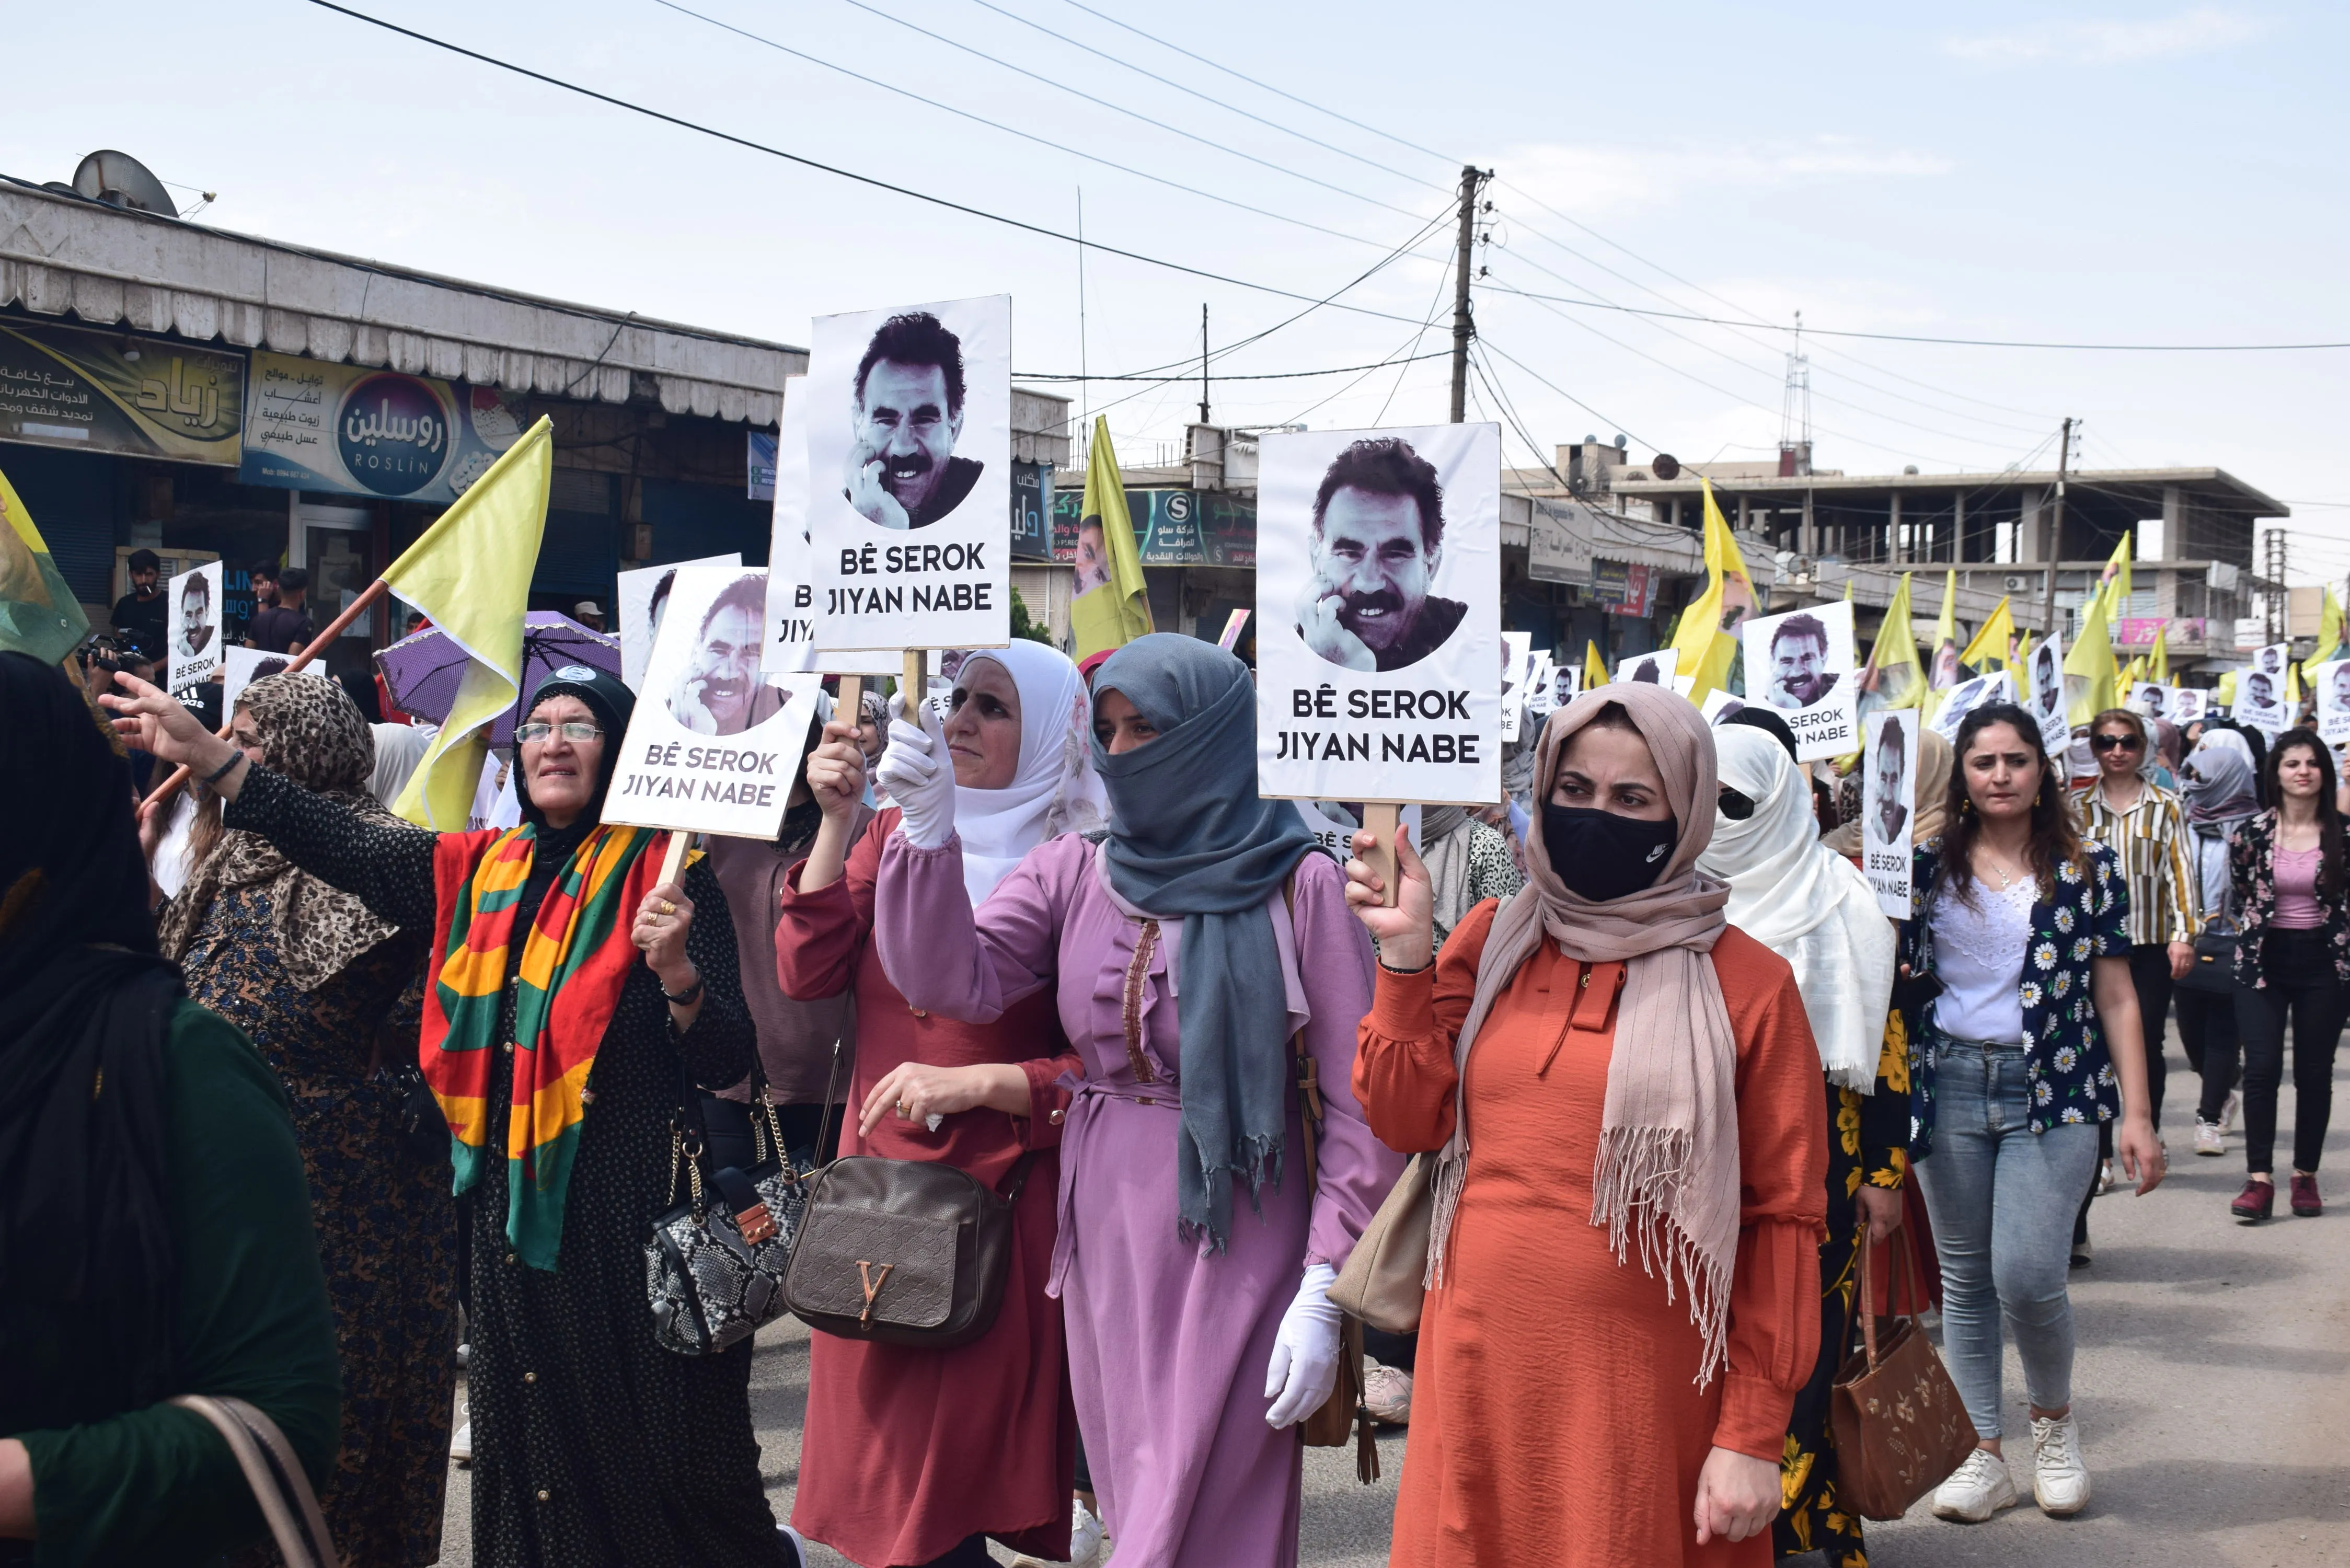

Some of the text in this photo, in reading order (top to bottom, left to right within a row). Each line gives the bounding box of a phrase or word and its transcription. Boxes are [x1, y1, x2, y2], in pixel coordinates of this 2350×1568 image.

[265, 367, 288, 381] موالح
[297, 373, 324, 387] توابل
[135, 356, 220, 429] زياد
[61, 410, 93, 421] تمديد
[262, 408, 320, 427] زيوت طبيعية
[347, 398, 442, 453] روسلين
[261, 431, 318, 445] عسل طبيعي
[1017, 472, 1040, 488] مكتب
[1158, 524, 1194, 535] شركة سلو
[840, 542, 985, 575] BÊ SEROK
[1146, 551, 1173, 562] النقدية
[794, 585, 812, 608] B
[828, 583, 992, 616] JIYAN NABE
[778, 619, 814, 643] JIY
[188, 656, 215, 675] SEROK
[1293, 683, 1471, 720] BÊ SEROK
[1790, 708, 1844, 729] SEROK
[1806, 725, 1849, 744] NABE
[1276, 732, 1480, 764] JIYAN NABE
[644, 741, 778, 775] BÊ SEROK
[622, 775, 776, 807] JIYAN NABE
[1882, 854, 1906, 873] SEROK
[1887, 880, 1908, 898] NABE
